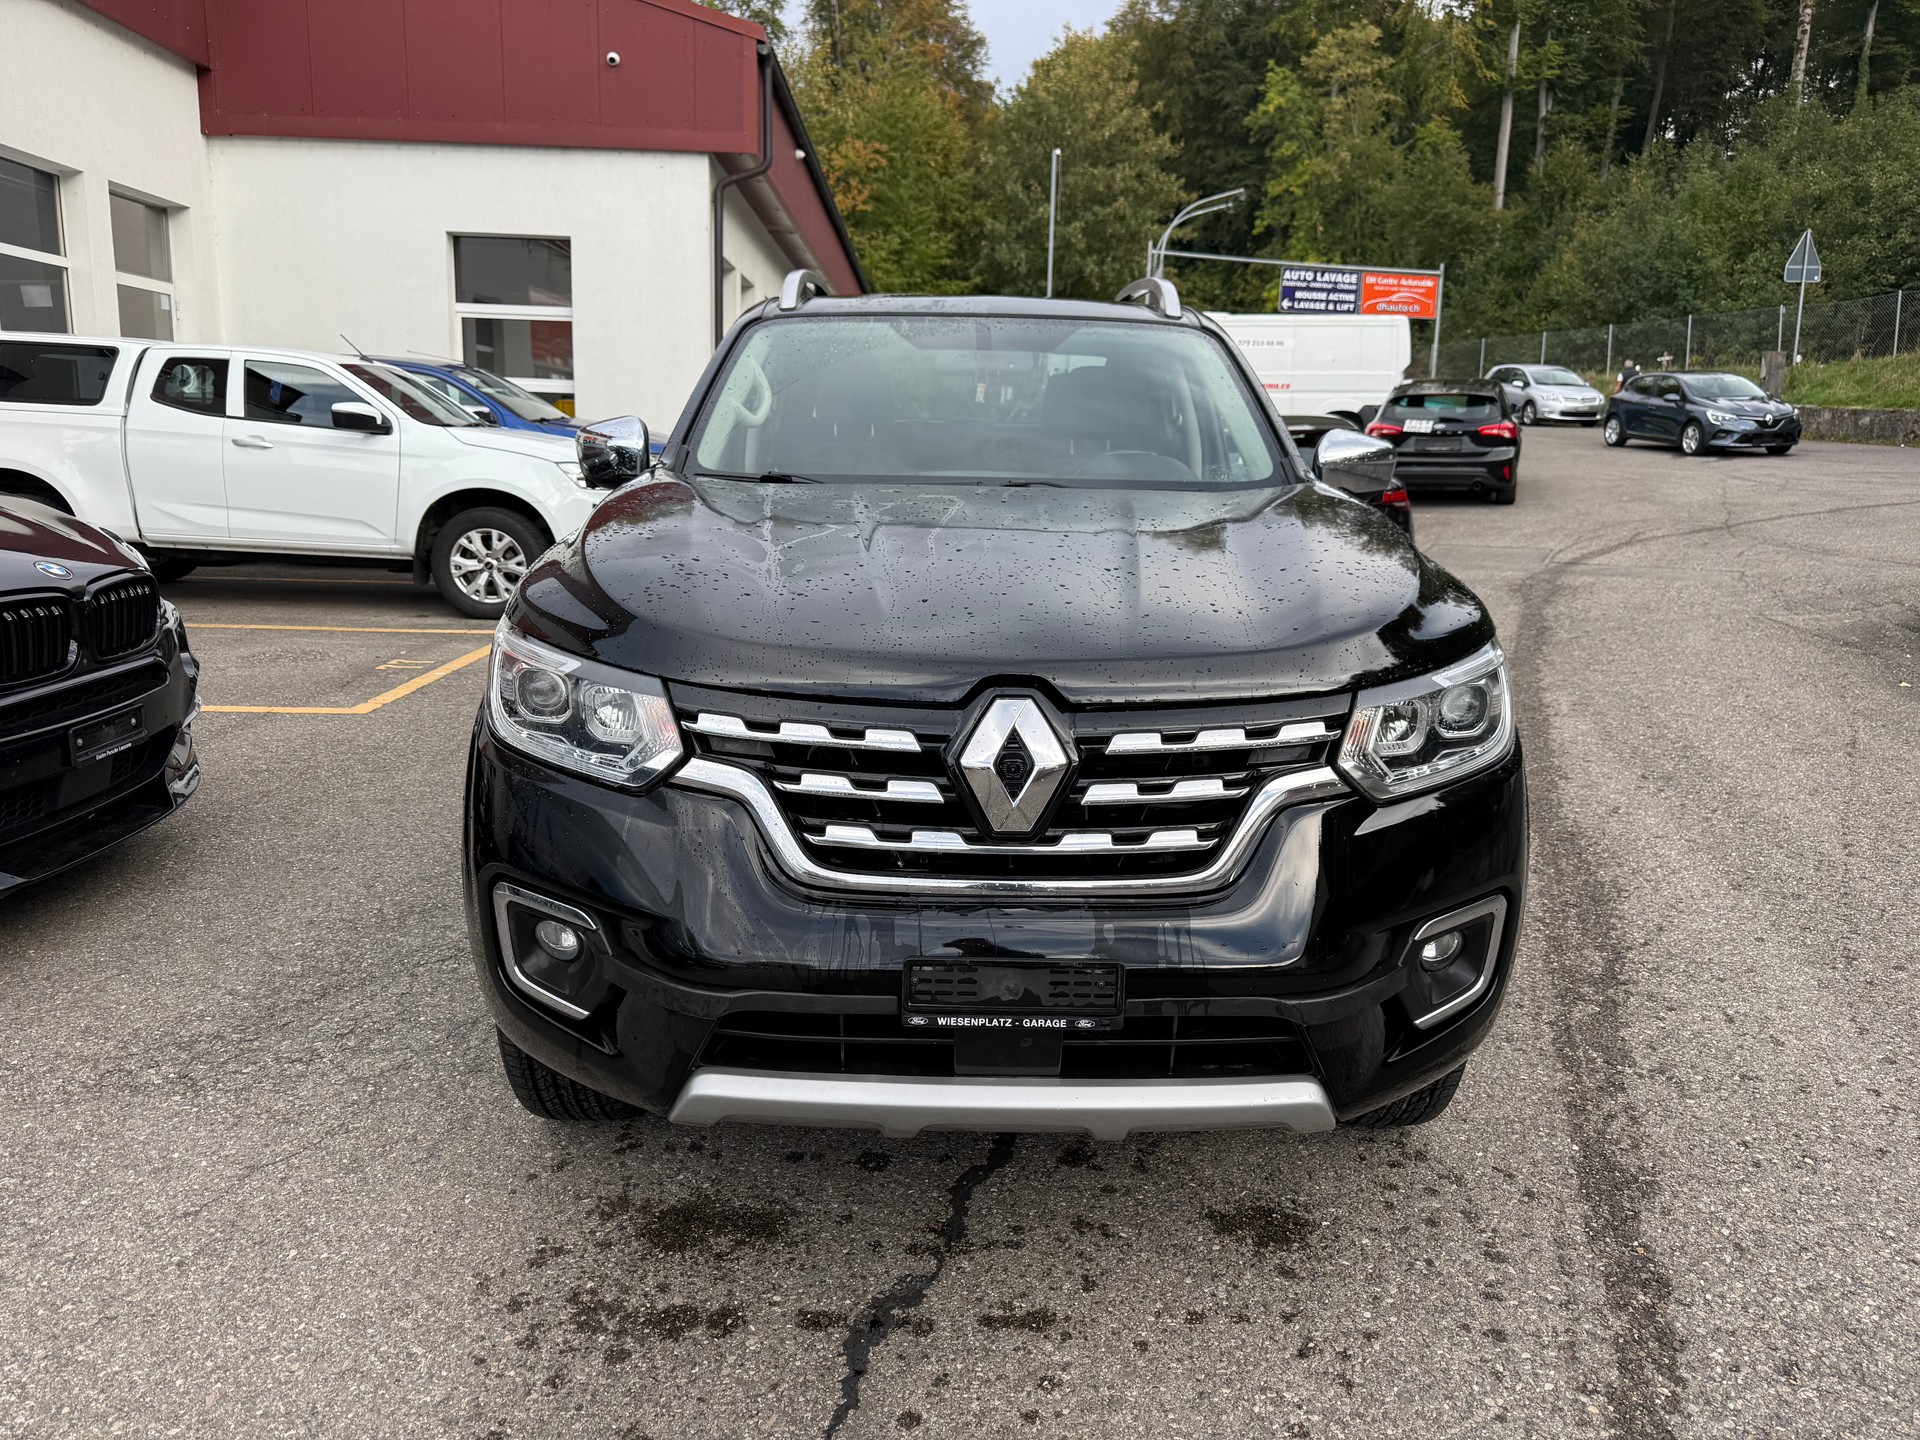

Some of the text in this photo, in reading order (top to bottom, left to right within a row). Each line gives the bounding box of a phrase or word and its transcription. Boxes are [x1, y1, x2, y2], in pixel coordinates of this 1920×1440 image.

[1283, 269, 1358, 284] AUTO LAVAGE
[1377, 276, 1398, 285] Centre
[1294, 290, 1356, 302] MOUSSE ACTIVE
[1293, 300, 1355, 312] LAVAGE & LIFT
[937, 1017, 1013, 1027] WIESENPLATZ
[1022, 1019, 1067, 1028] GARAGE
